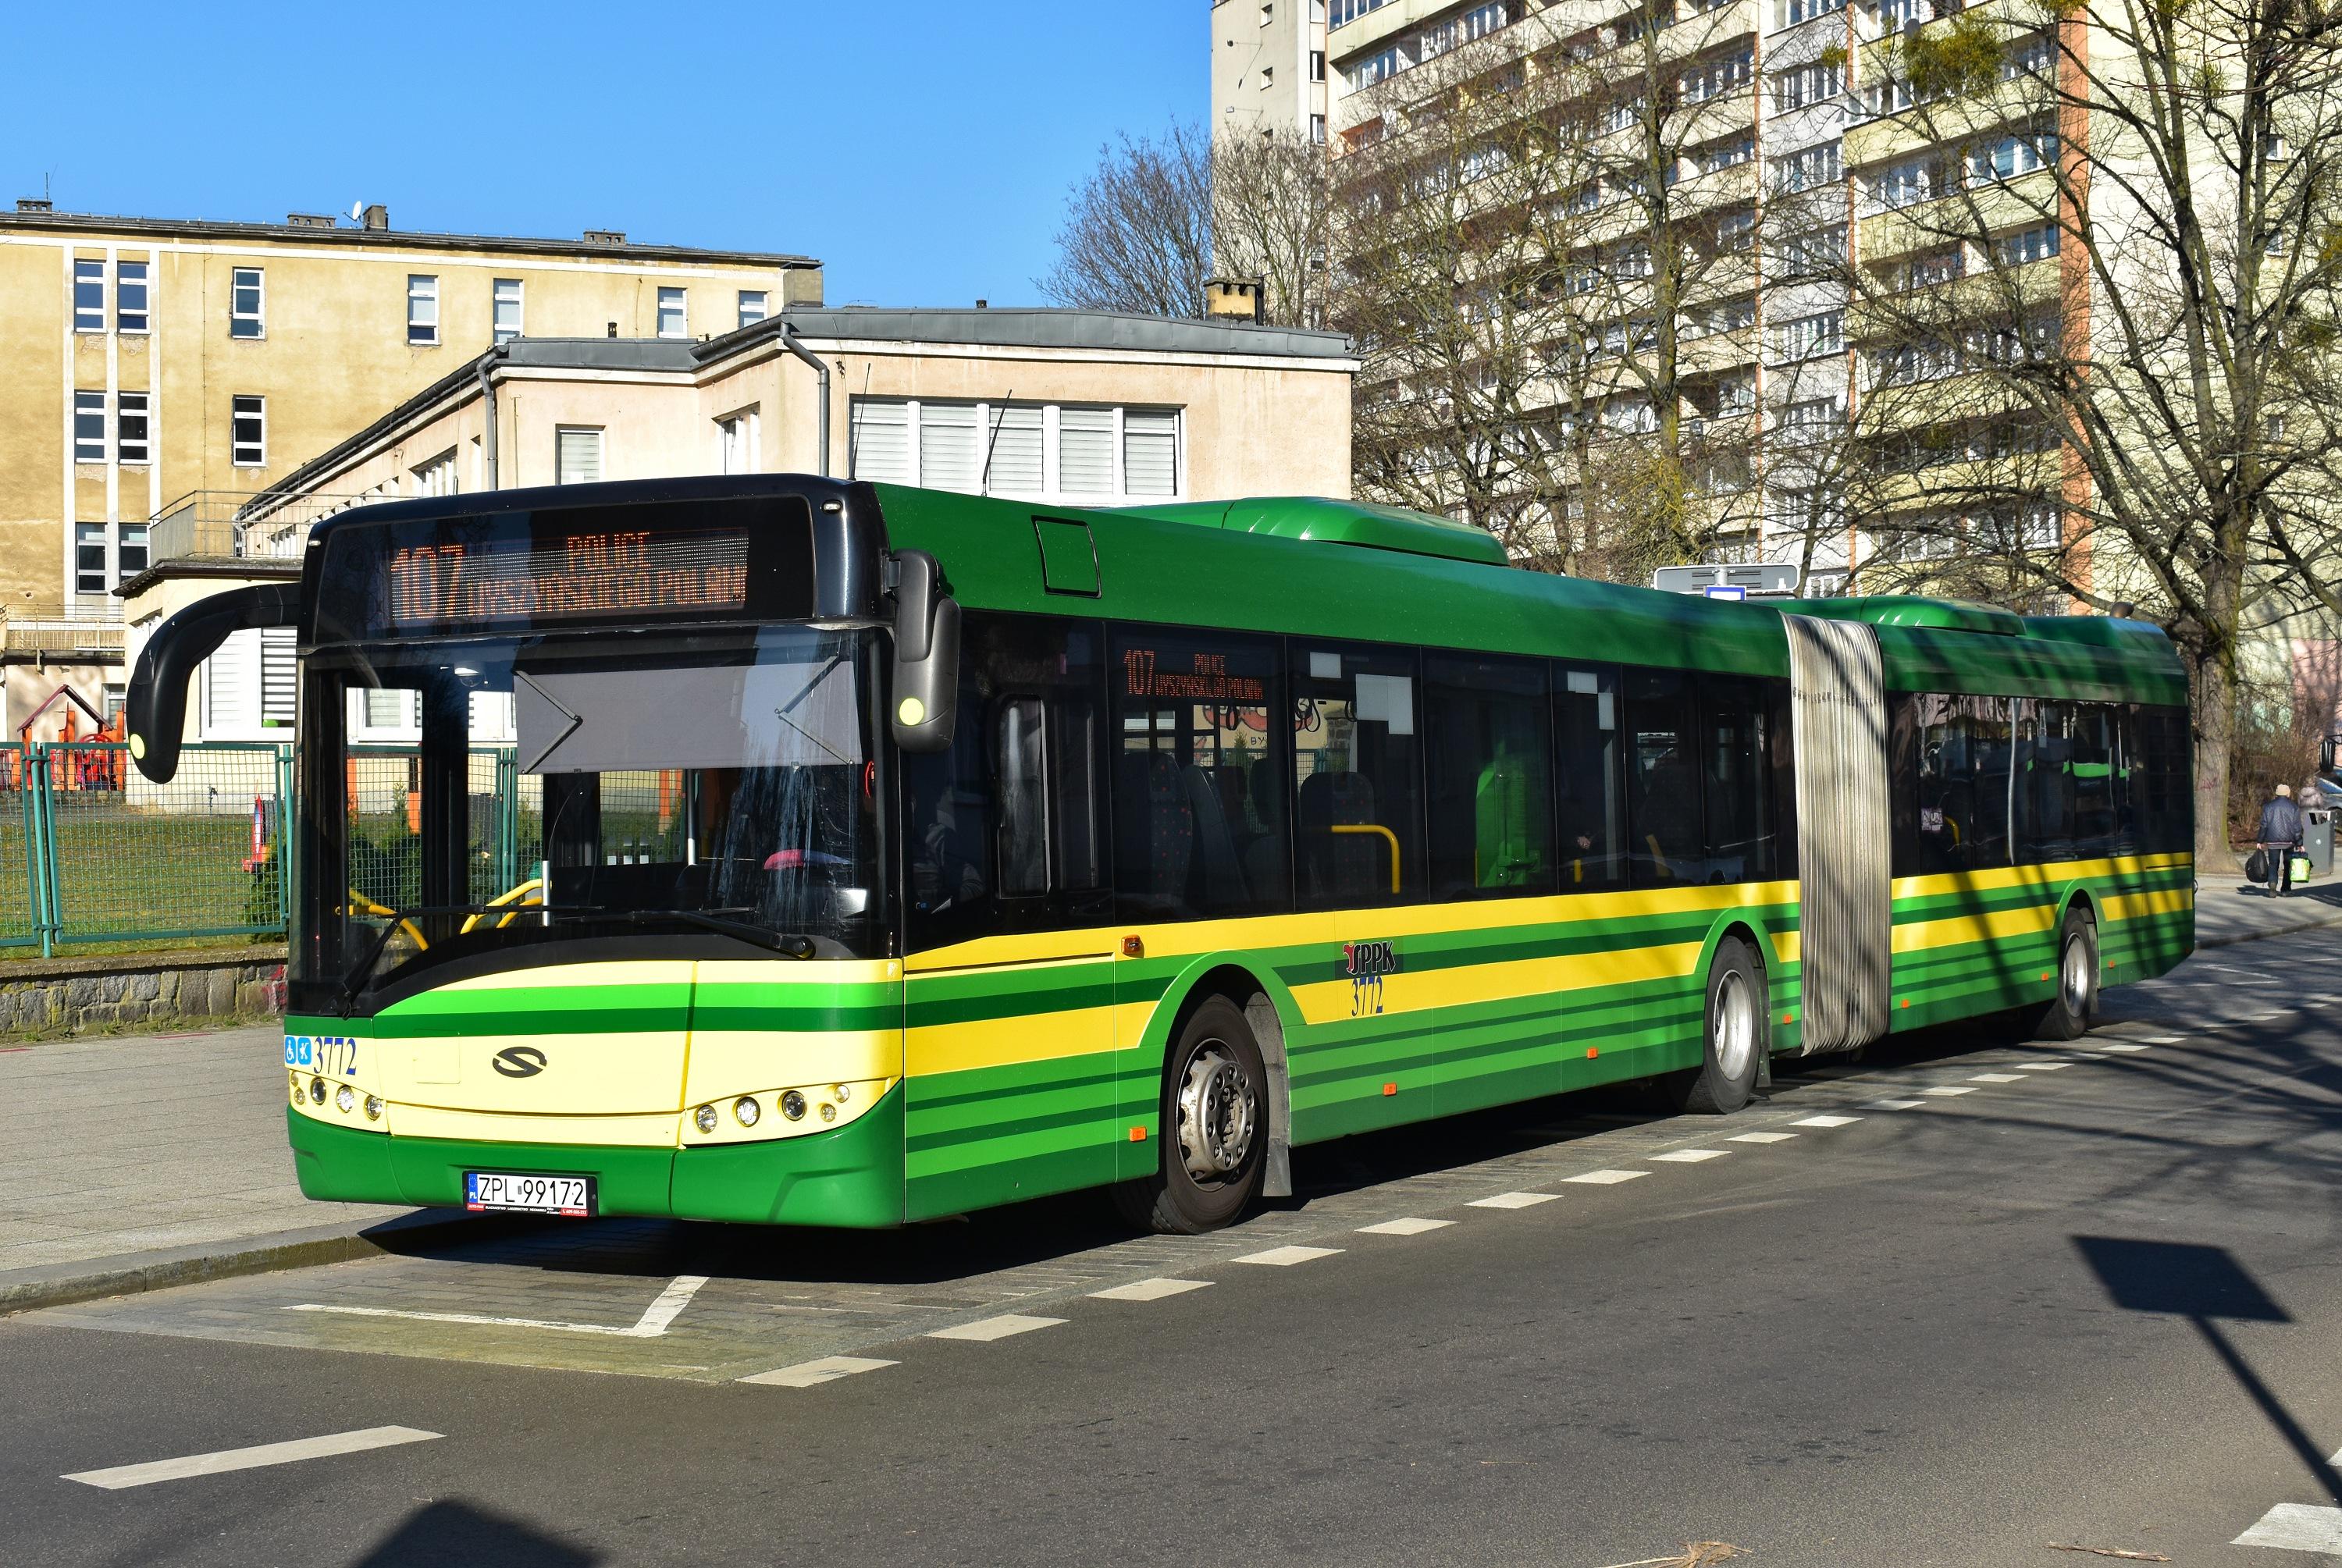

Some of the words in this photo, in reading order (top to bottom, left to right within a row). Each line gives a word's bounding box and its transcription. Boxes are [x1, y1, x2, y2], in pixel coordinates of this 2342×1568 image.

[568, 531, 652, 572] POLICE
[391, 545, 466, 620] 107
[1123, 649, 1155, 695] 107
[1194, 653, 1226, 676] POLICE
[1351, 976, 1384, 1017] 3772
[313, 1036, 357, 1076] 3772
[469, 1191, 478, 1200] PL
[479, 1177, 515, 1203] ZPL
[523, 1179, 584, 1207] 99172
